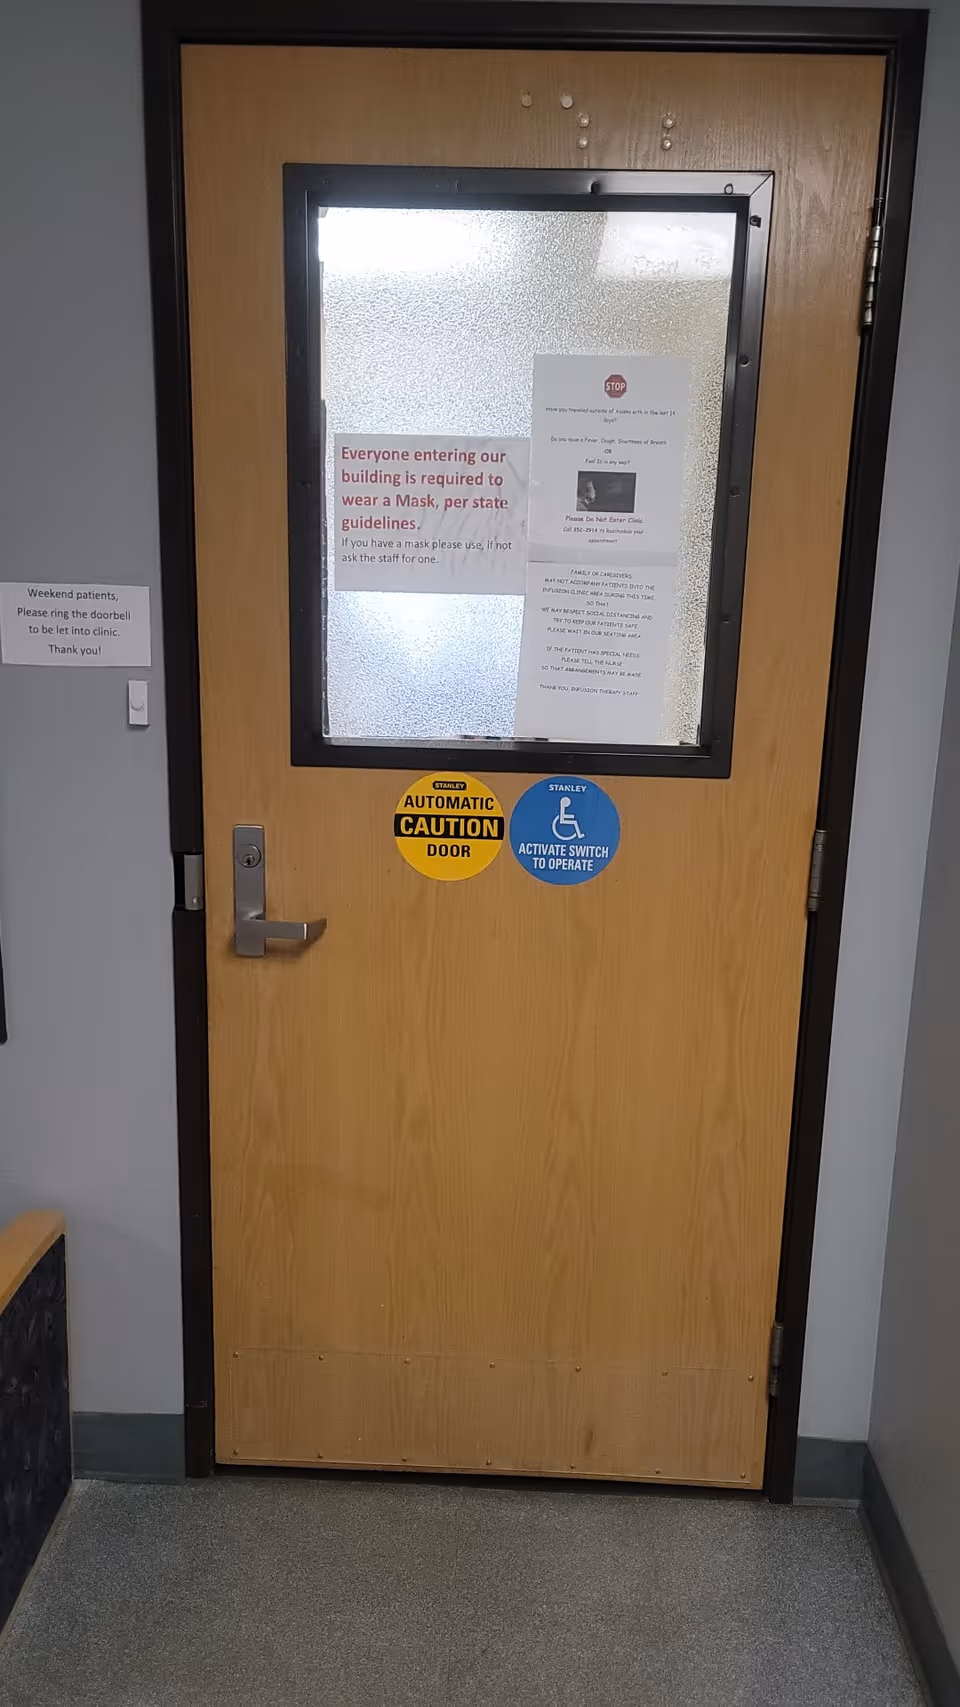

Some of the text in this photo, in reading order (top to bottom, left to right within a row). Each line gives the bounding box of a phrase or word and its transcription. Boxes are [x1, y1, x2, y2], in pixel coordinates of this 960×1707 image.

[606, 382, 626, 390] STOP
[341, 447, 506, 465] Everyone entering our
[341, 470, 503, 488] building is required to
[342, 494, 508, 511] wear a Mask, per state
[341, 516, 421, 531] guidelines.
[342, 538, 348, 547] If
[351, 539, 368, 549] you
[372, 539, 394, 548] have
[405, 539, 429, 549] mask
[432, 540, 462, 551] please
[465, 541, 484, 551] use,
[487, 540, 494, 549] if
[496, 541, 512, 549] not
[342, 553, 439, 564] ask the staff for one.
[602, 581, 628, 589] PATIENTS
[28, 588, 118, 602] Weekend patients,
[18, 608, 130, 620] Please ring the doorbell
[29, 625, 120, 636] to be let into clinic.
[48, 644, 101, 656] Thank you!
[565, 647, 587, 655] PATIENT
[565, 667, 606, 675] ARRANGEMENTS
[549, 784, 587, 792] STANLEY
[404, 795, 494, 810] AUTOMATIC
[400, 816, 498, 837] CAUTION
[427, 844, 470, 857] DOOR
[518, 843, 609, 858] ACTIVATE SWITCH
[533, 858, 593, 871] TO OPERATE
